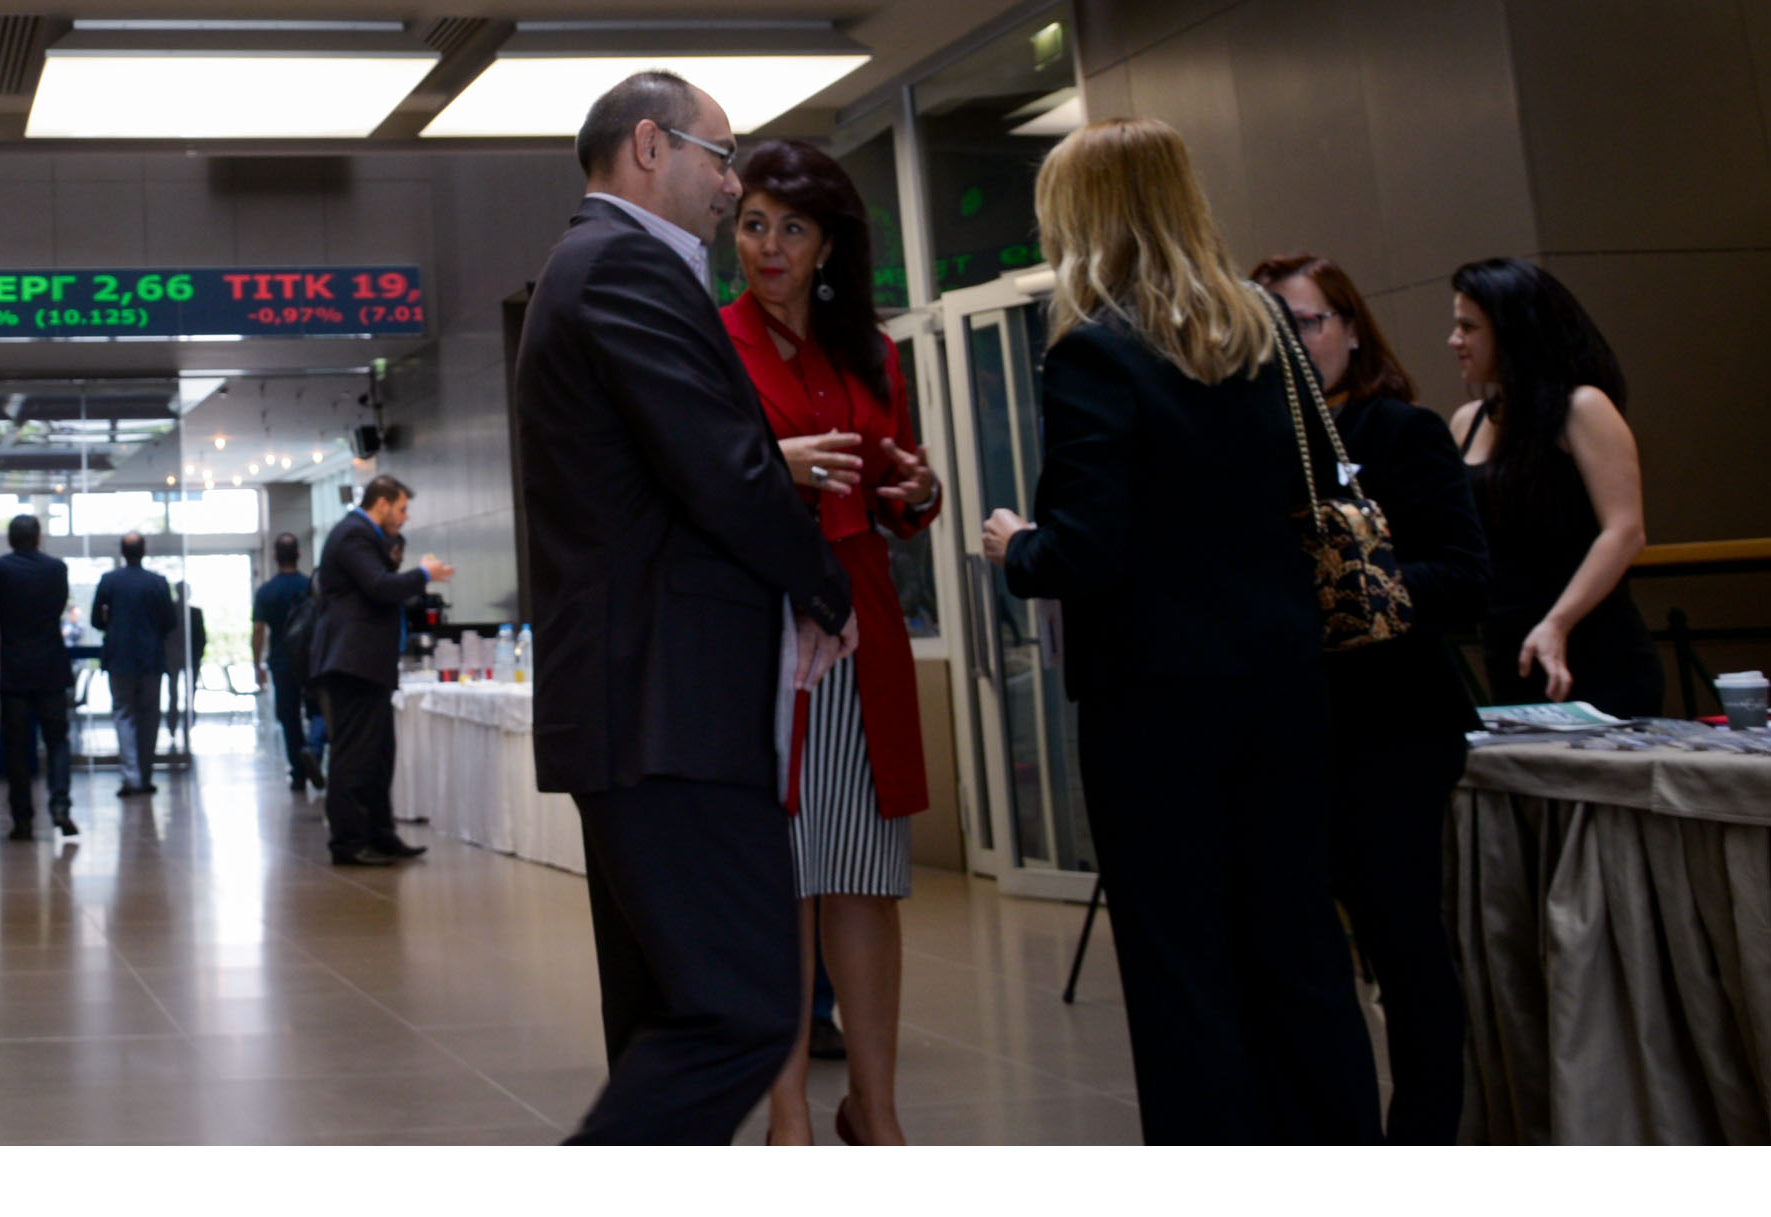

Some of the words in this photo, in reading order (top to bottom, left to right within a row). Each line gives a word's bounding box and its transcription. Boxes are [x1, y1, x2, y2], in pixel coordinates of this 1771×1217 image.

[93, 274, 195, 306] 2,66
[223, 273, 336, 301] ΤΙΤΚ
[34, 306, 149, 330] (10.125)
[248, 306, 344, 327] -0,97%
